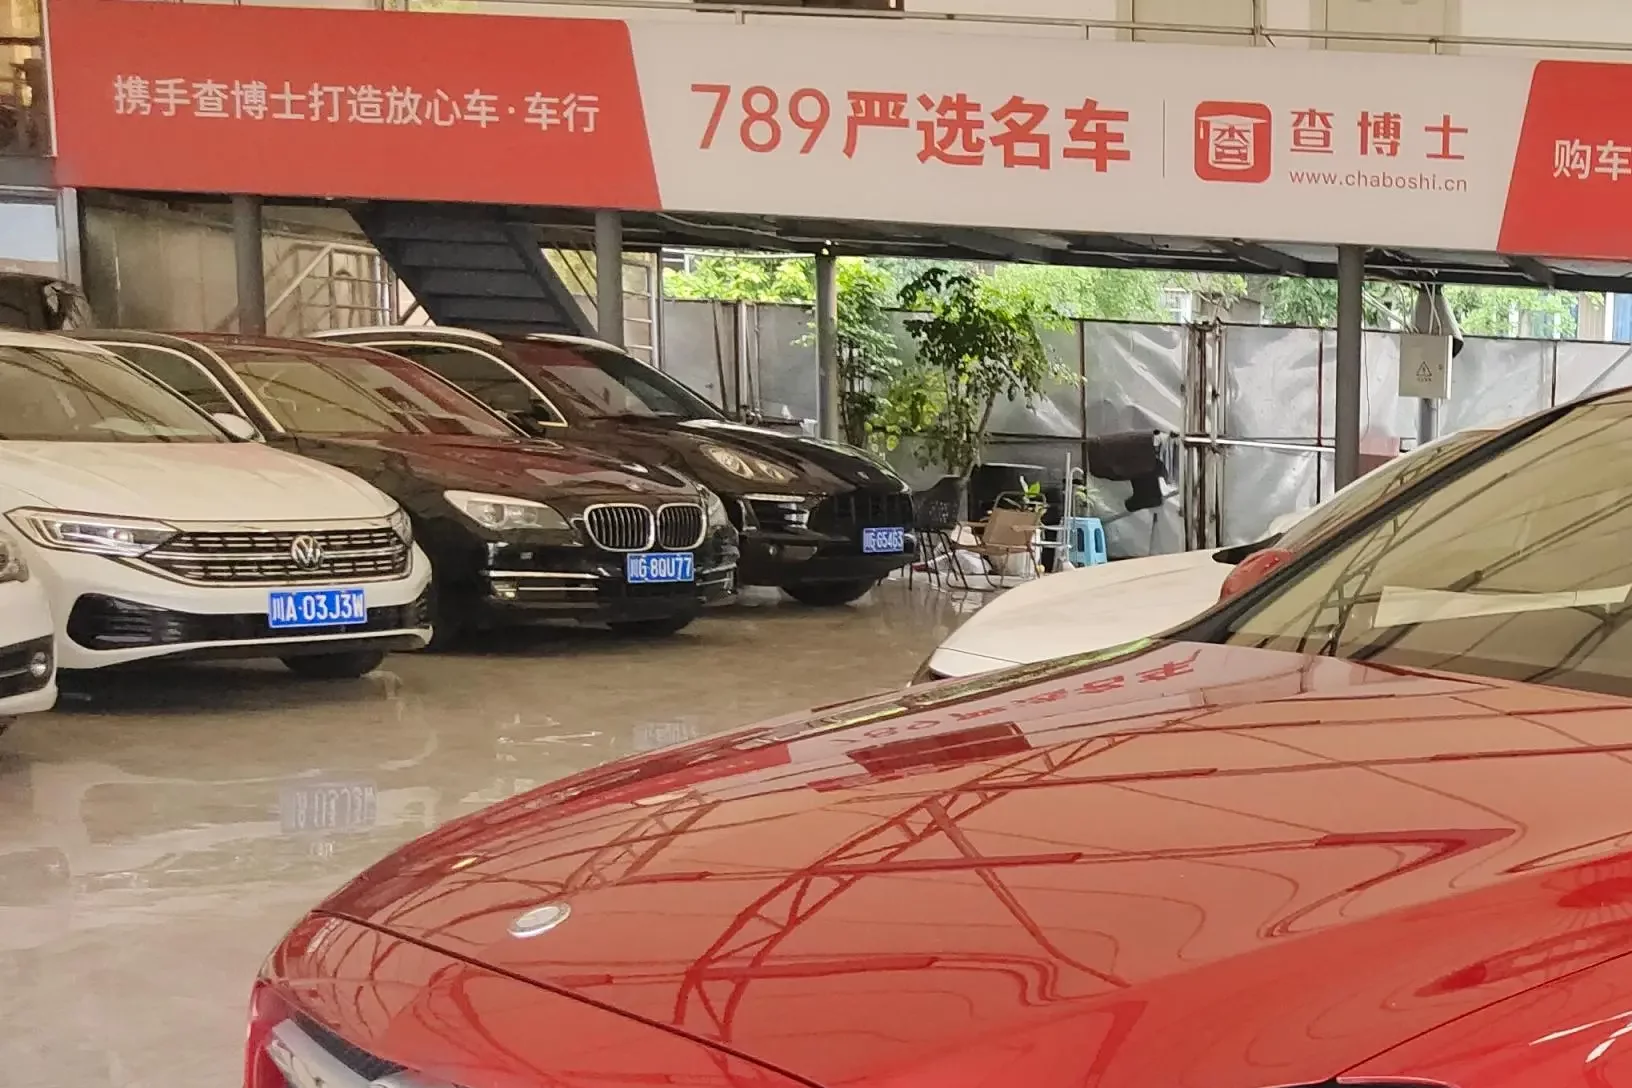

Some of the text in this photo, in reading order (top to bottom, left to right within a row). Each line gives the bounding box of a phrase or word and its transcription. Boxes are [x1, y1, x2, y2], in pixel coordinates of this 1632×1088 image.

[113, 75, 600, 134] 携手查博士打造放心车·车行
[690, 83, 1131, 173] 789严选名车
[1289, 107, 1469, 160] 查博士
[1289, 169, 1468, 193] www.chaboshi.cn
